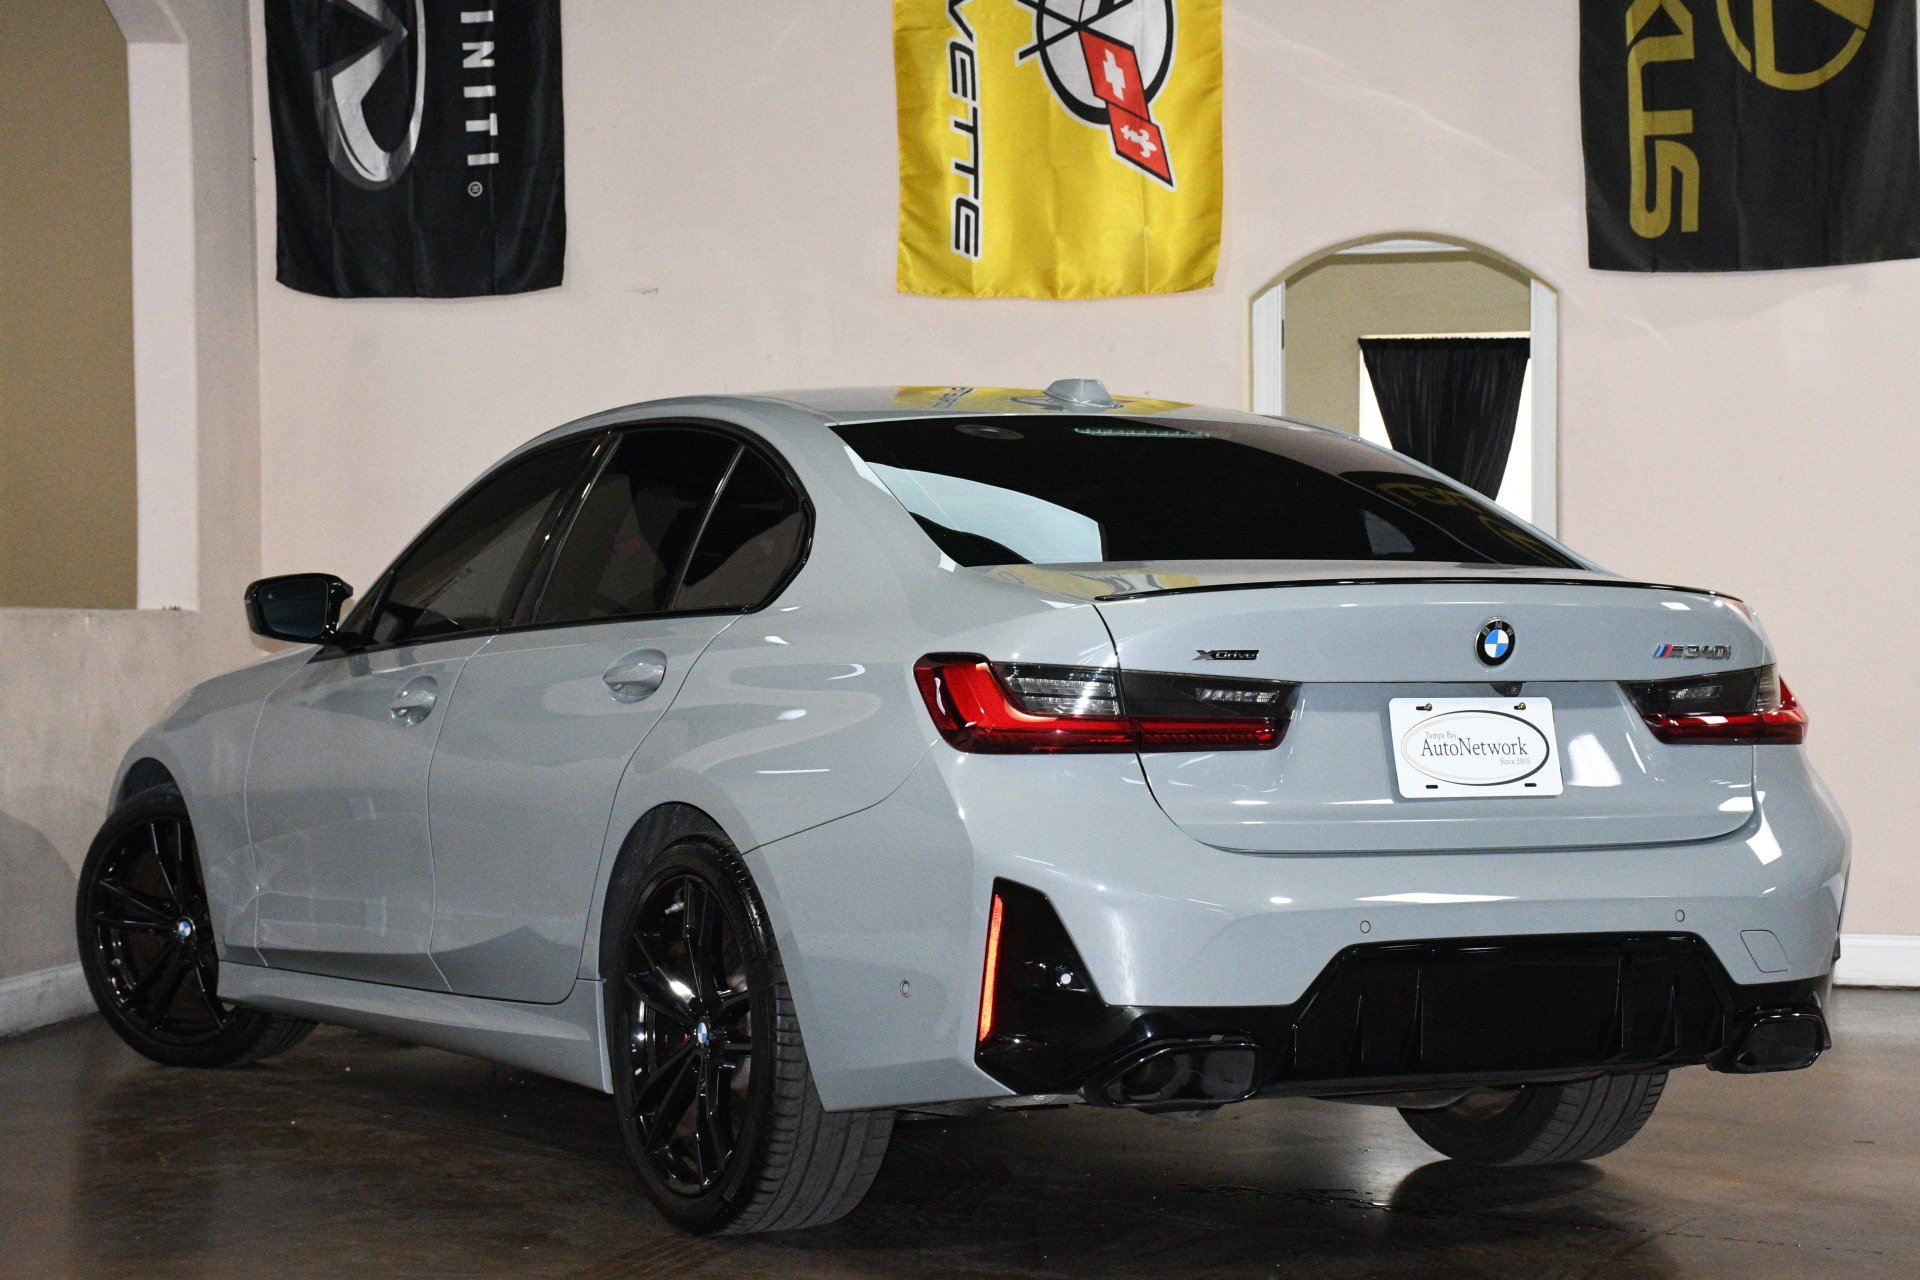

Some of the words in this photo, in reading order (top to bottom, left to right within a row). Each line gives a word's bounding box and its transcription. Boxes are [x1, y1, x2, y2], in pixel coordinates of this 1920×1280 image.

[1425, 731, 1445, 741] Tampa
[1446, 731, 1457, 739] Bay
[1421, 736, 1528, 757] AutoNetwork
[1499, 757, 1515, 765] Since
